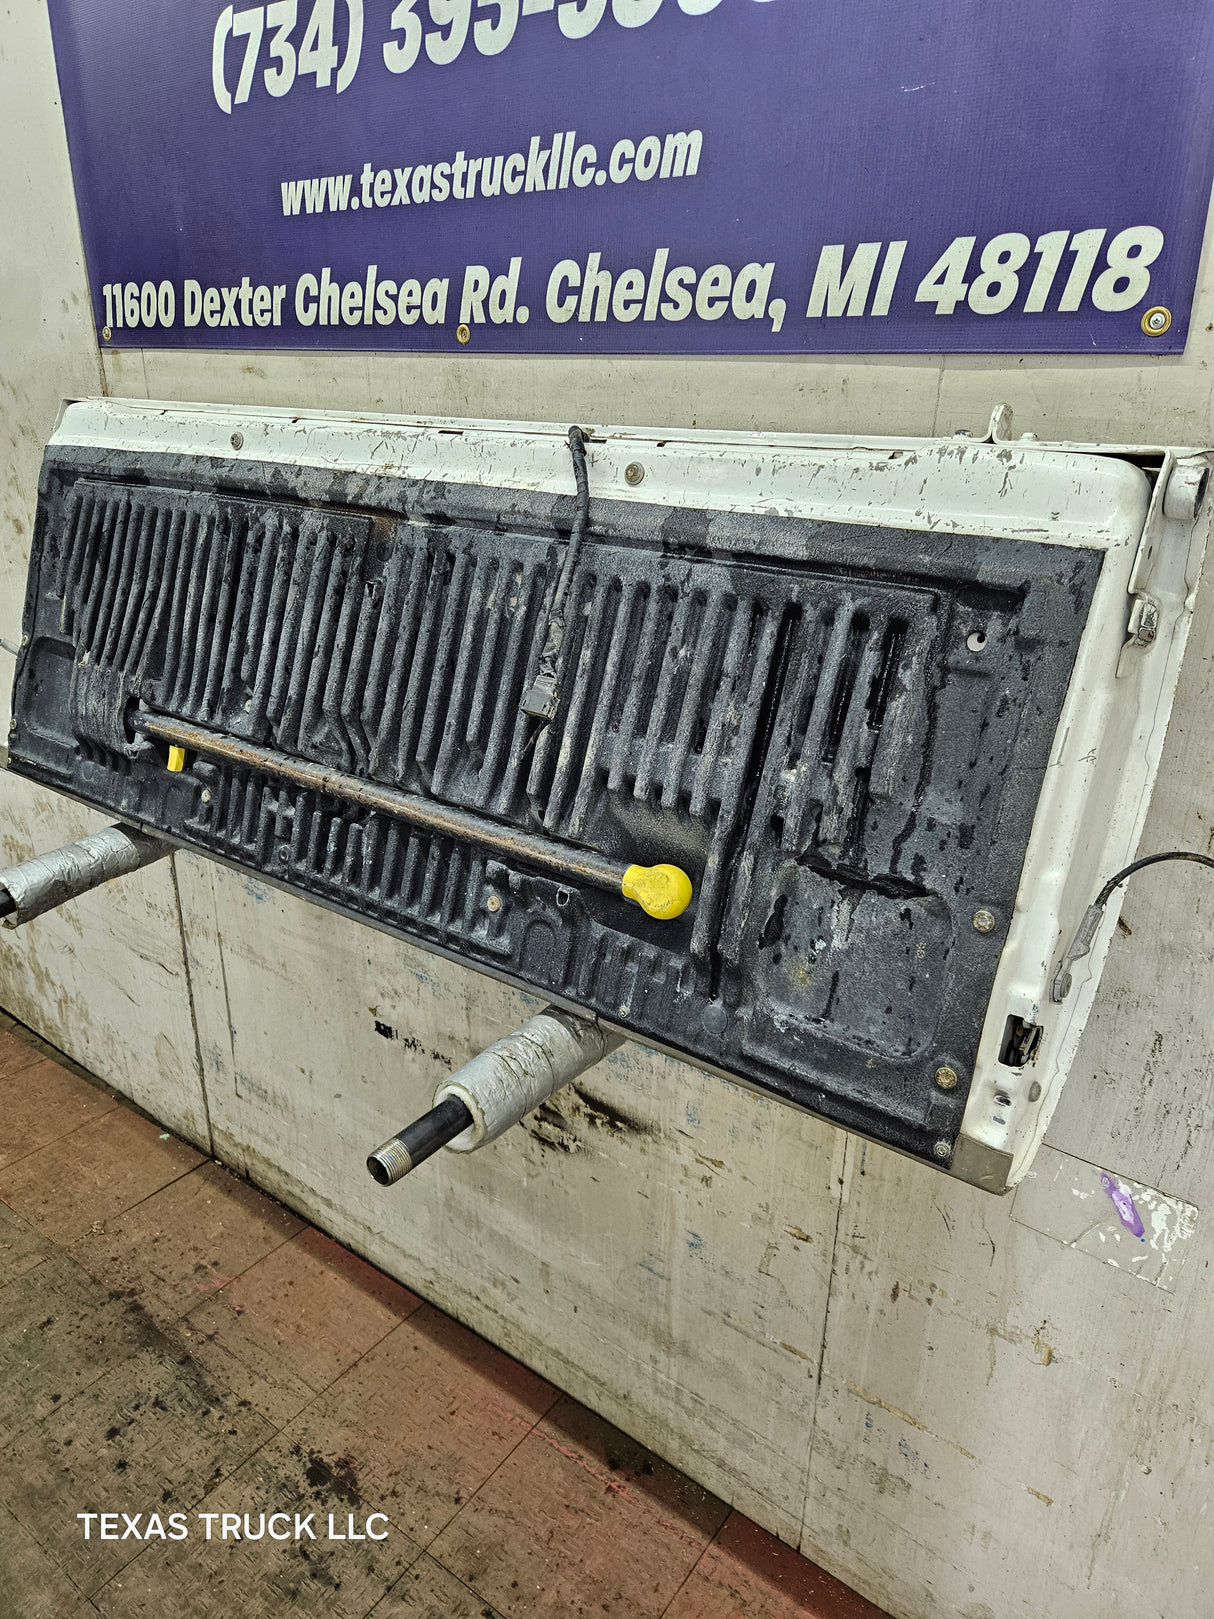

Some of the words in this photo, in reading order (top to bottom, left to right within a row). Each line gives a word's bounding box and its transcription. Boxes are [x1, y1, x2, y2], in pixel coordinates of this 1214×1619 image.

[211, 0, 364, 114] (734)
[280, 129, 703, 217] www.texastruckllc.com
[102, 281, 176, 329] 11600
[184, 276, 286, 328] Dexter
[294, 264, 450, 327] Chelsea
[459, 256, 530, 325] Rd.
[545, 247, 787, 333] Chelsea,
[805, 239, 909, 318] MI
[914, 225, 1165, 316] 48118
